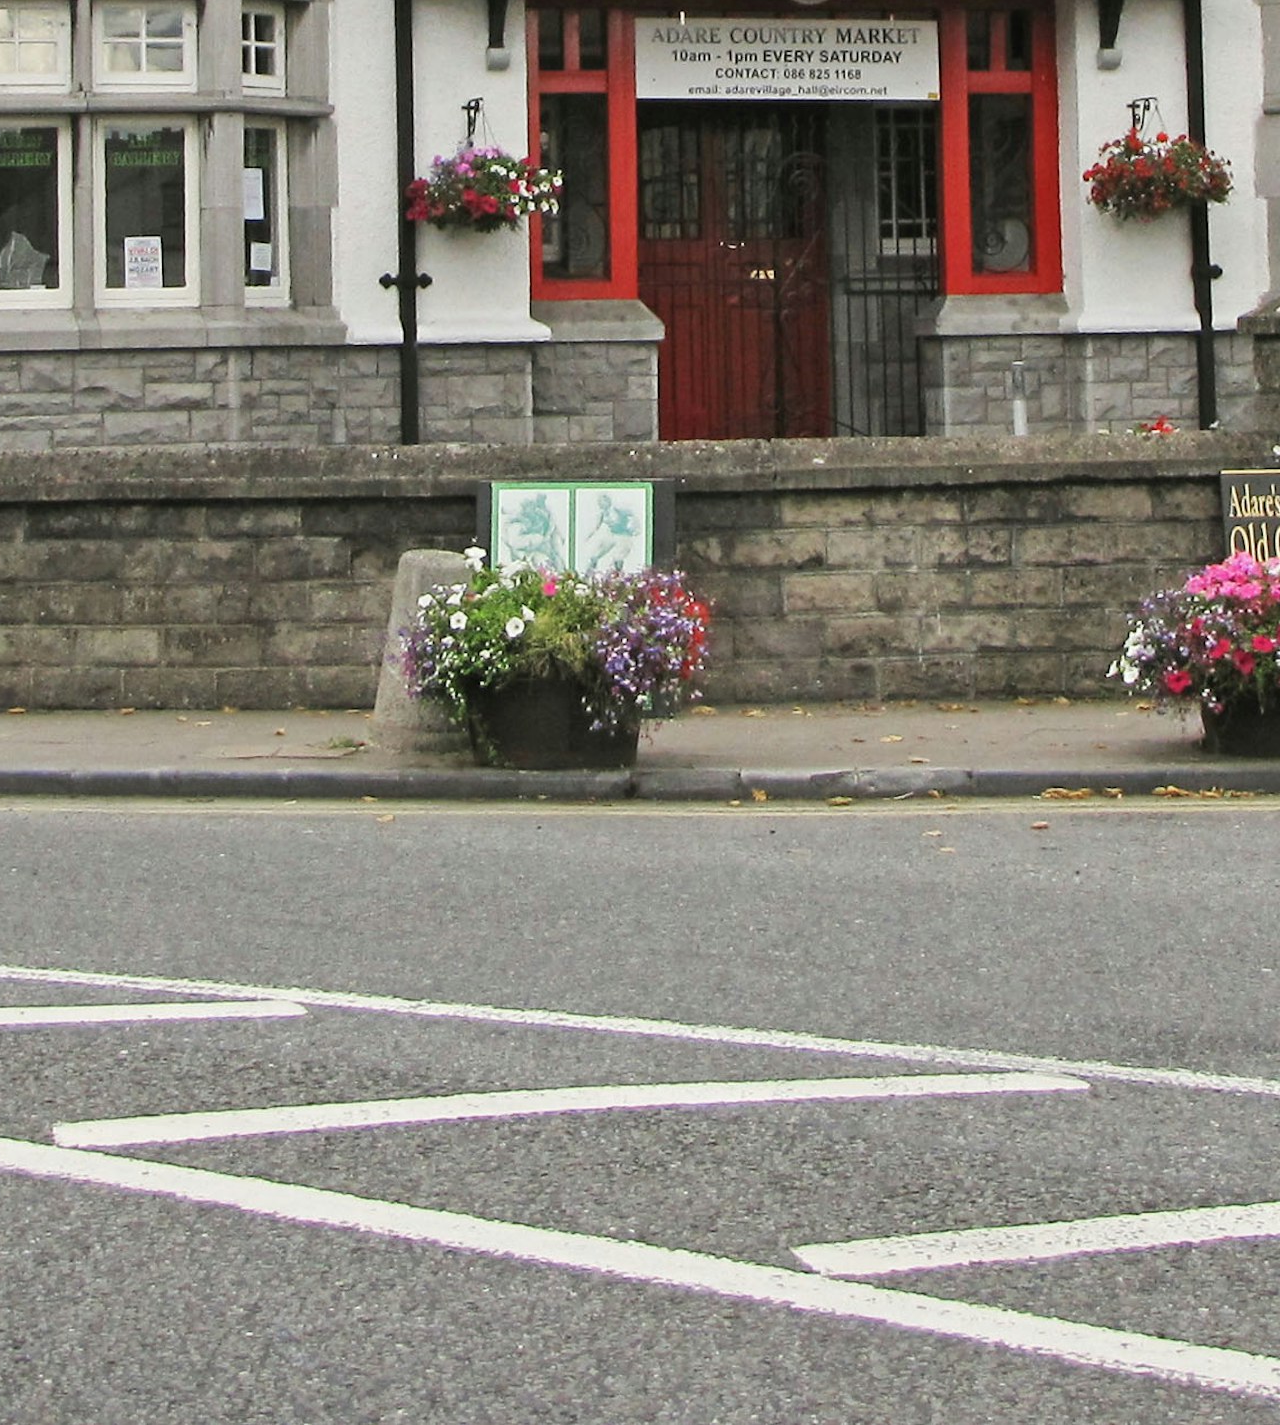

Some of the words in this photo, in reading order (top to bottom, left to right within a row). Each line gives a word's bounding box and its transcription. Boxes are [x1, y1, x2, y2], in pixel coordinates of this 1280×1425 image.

[651, 27, 721, 44] ADARE
[730, 27, 827, 45] COUNTRY
[836, 27, 919, 45] MARKET
[672, 49, 711, 62] 10am
[727, 49, 758, 65] 1pm
[763, 50, 815, 63] EVERY
[820, 50, 902, 64] SATURDAY
[715, 68, 780, 79] CONTACT:
[783, 68, 806, 80] 086
[809, 68, 830, 80] 825
[834, 69, 862, 80] 1168
[688, 84, 721, 95] email:
[725, 84, 888, 97] adarevillage_hall@eircom.net
[1230, 522, 1270, 563] Old
